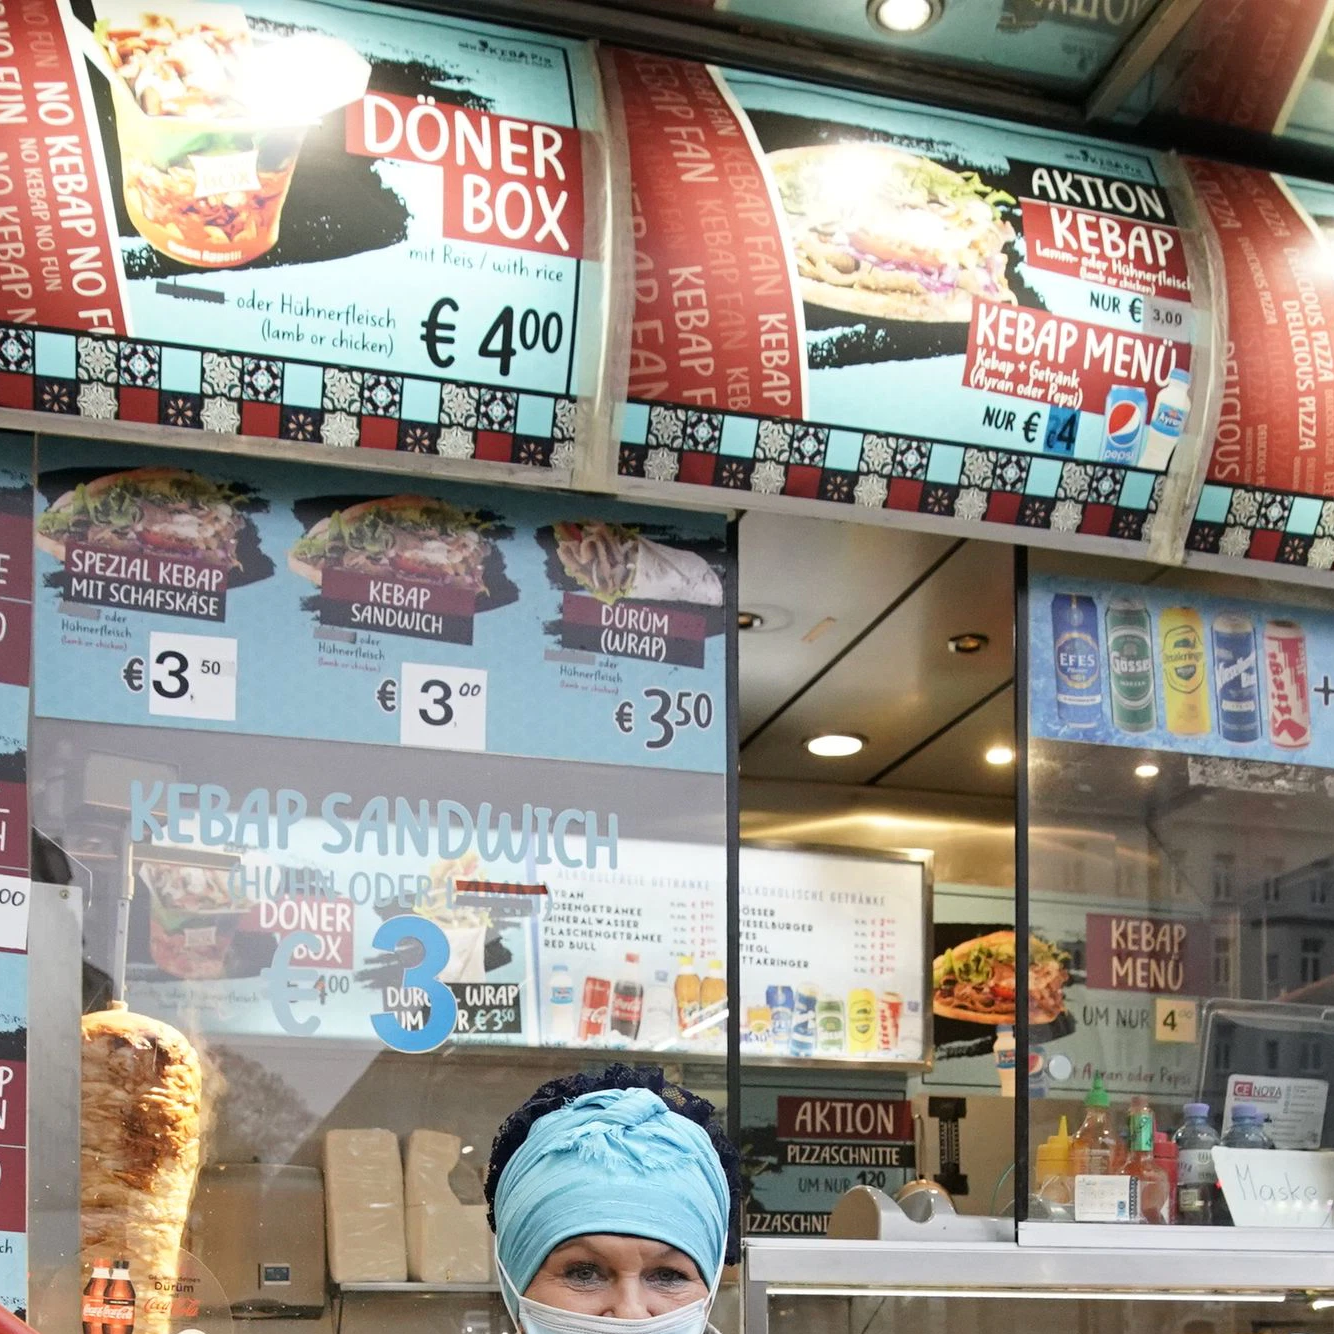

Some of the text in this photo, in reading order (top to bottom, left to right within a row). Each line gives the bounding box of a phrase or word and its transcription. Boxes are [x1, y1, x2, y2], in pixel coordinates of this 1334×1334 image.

[363, 94, 566, 181] DÖNER
[1032, 167, 1165, 219] AKTION
[463, 173, 570, 252] BOX
[1050, 207, 1173, 266] KEBAP
[410, 248, 563, 282] mit Reis with rice
[237, 290, 271, 312] oder
[281, 292, 396, 329] Hühnerfleisch
[1090, 291, 1120, 313] NUR
[261, 319, 394, 357] (lamb chicken)
[976, 303, 1176, 386] KEBAP MENÜ
[983, 406, 1017, 431] NUR
[71, 550, 223, 592] SPEZIAL KEBAP
[71, 578, 219, 618] MIT SCHAFSKÄSE
[369, 580, 430, 611] KEBAP
[351, 603, 444, 636] SANDWICH
[602, 603, 669, 635] DÜRÜM
[600, 628, 667, 662] (WRAP)
[1060, 652, 1096, 668] EFES
[129, 779, 620, 870] KEBAP SANDWICH
[348, 870, 431, 909] ODER
[1111, 919, 1187, 954] KEBAP
[370, 914, 457, 1054] 3
[1111, 953, 1183, 991] MENÜ
[466, 985, 518, 1007] WRAP
[1083, 1005, 1150, 1029] UM NUR
[795, 1101, 894, 1135] AKTION
[787, 1144, 899, 1165] PIZZASCHNITTE
